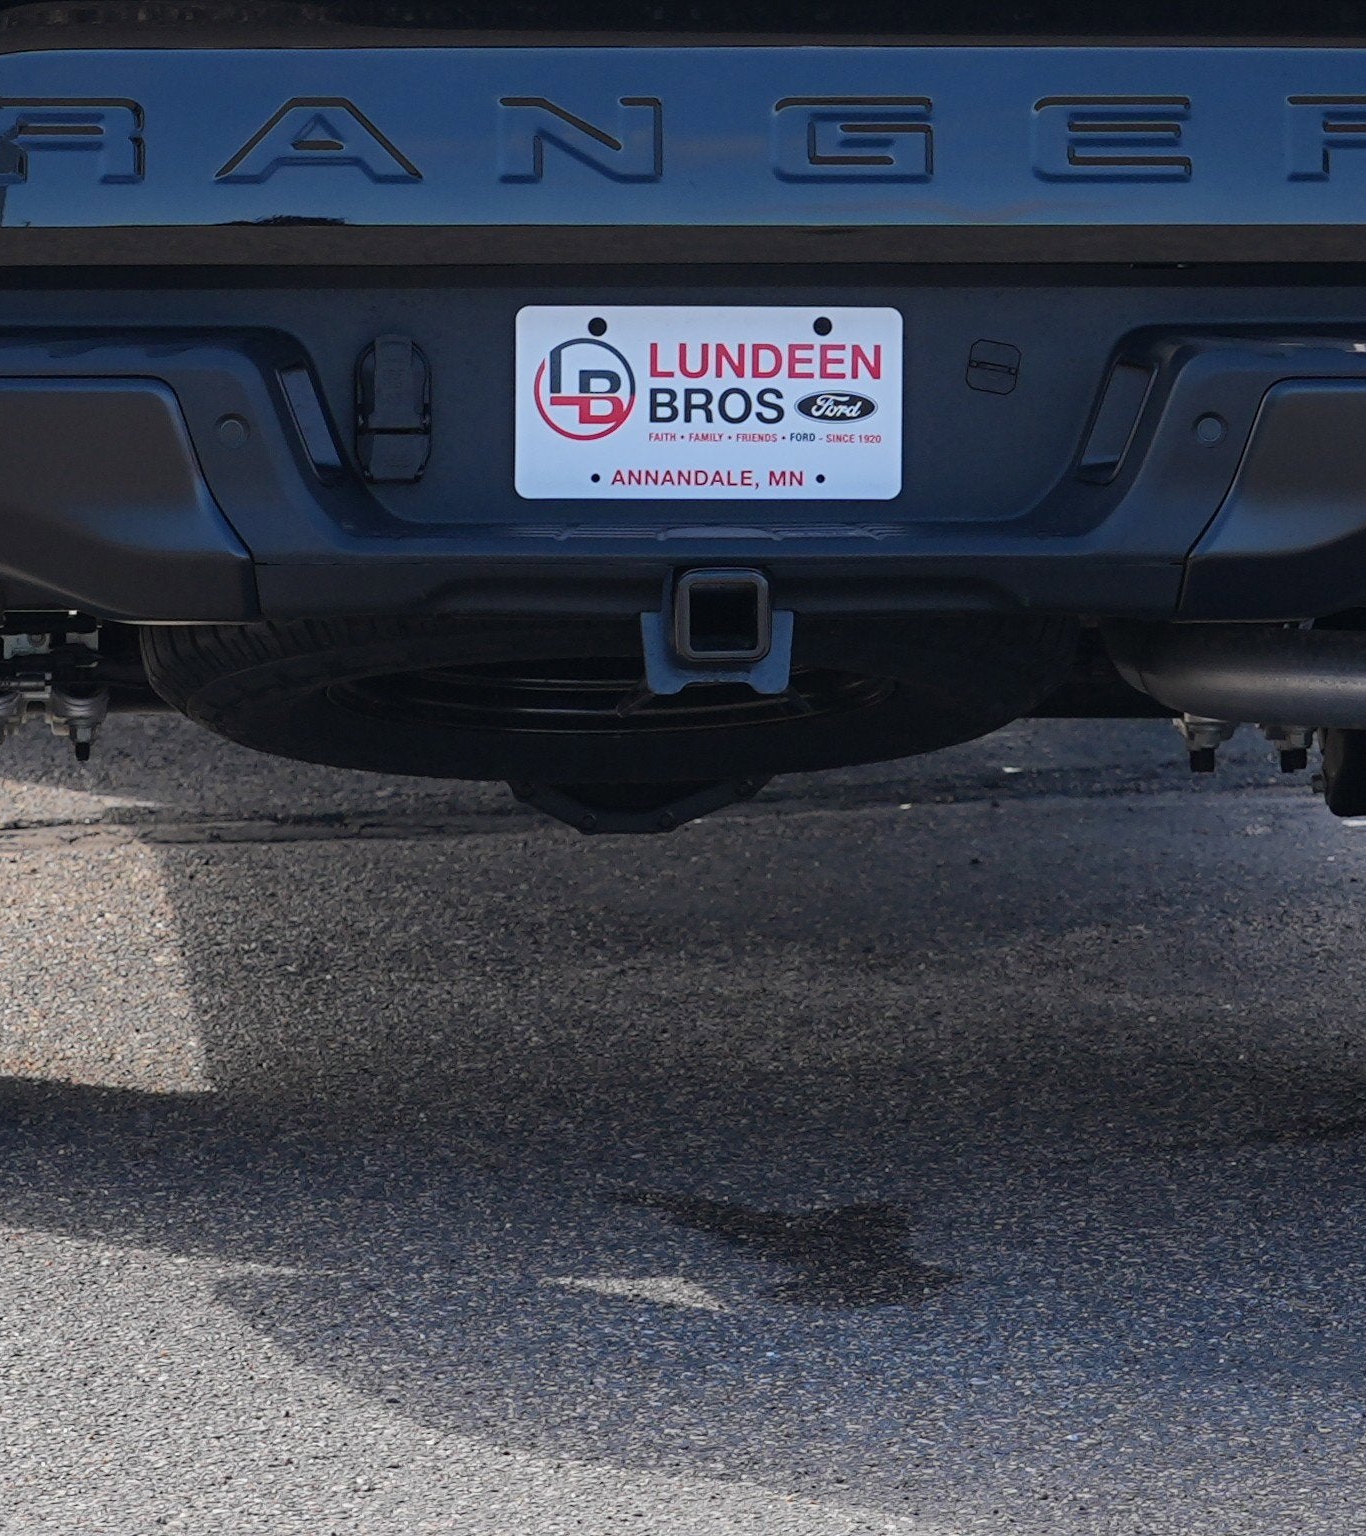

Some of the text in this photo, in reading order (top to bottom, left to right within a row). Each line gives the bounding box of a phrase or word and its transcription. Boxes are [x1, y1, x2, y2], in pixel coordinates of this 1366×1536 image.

[649, 342, 882, 380] LUNDEEN
[649, 388, 785, 424] BROS
[648, 432, 882, 444] FAITH FAMILY FRIENDS FORD SINCE 1920
[610, 469, 804, 489] ANNANDALE, MN
